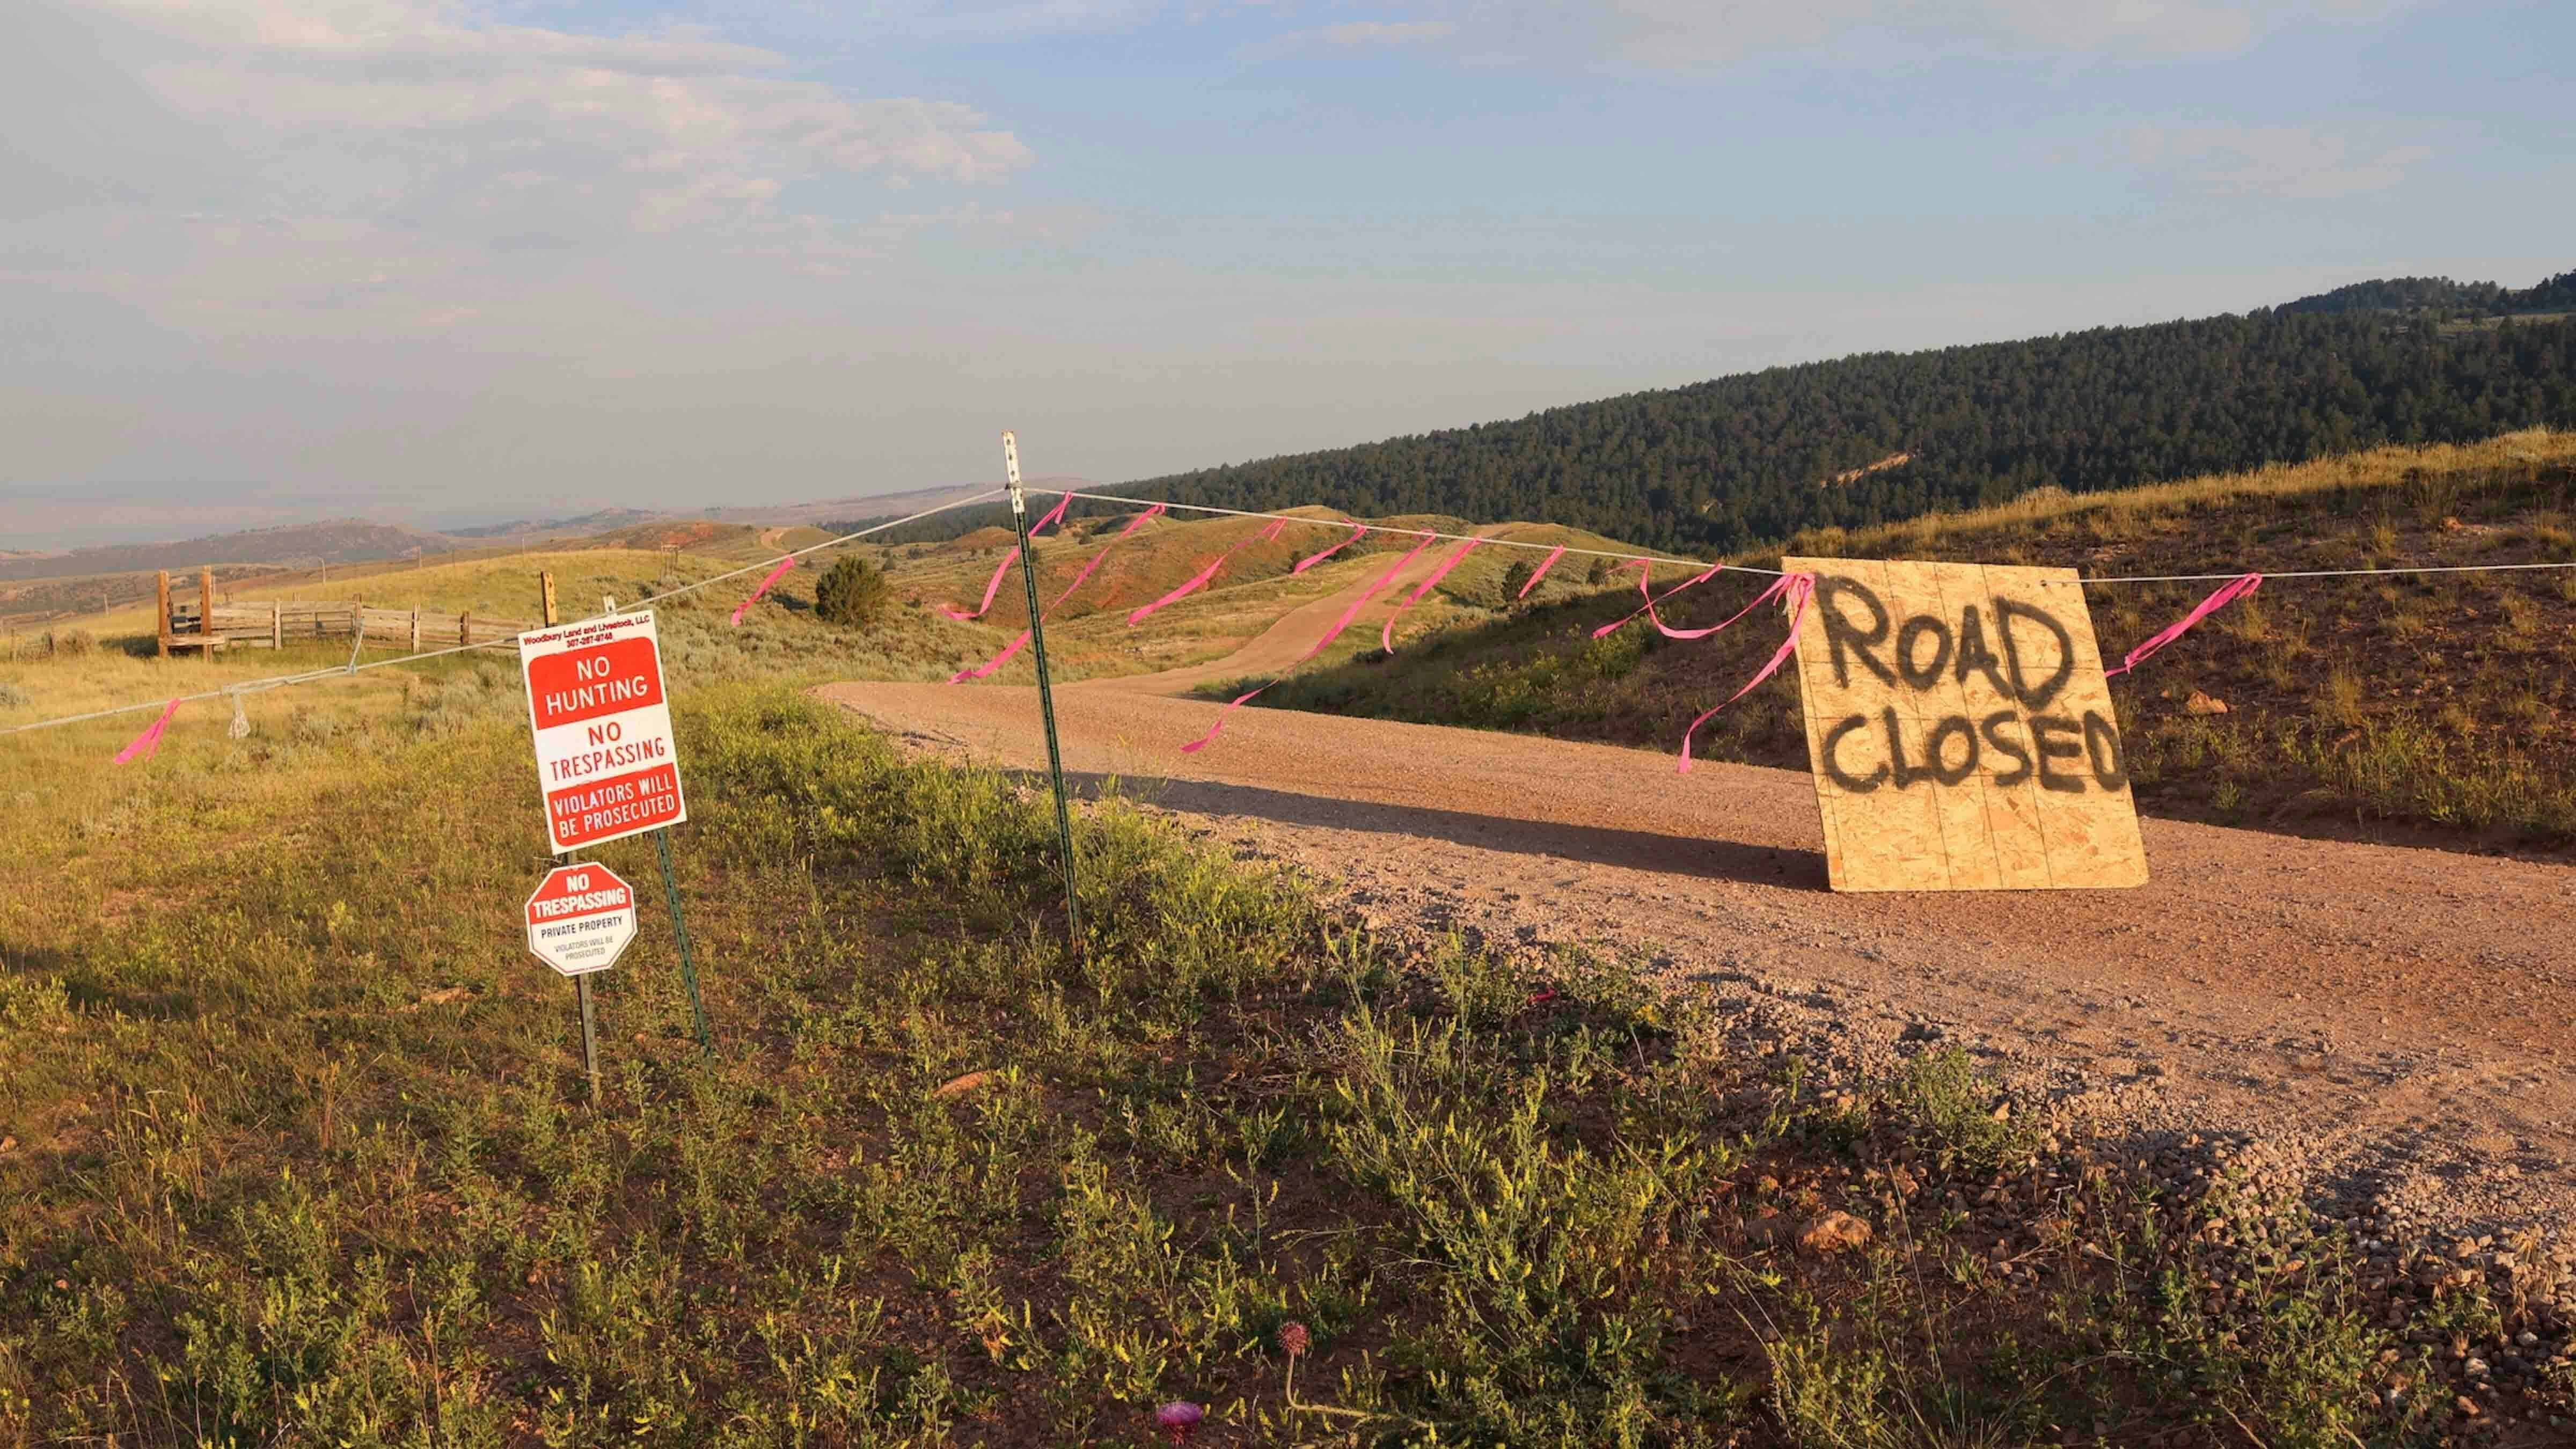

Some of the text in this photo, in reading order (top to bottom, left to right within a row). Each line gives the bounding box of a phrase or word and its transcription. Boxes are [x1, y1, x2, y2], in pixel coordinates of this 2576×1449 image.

[524, 615, 650, 646] Woodbury Land and Livestock, LLC
[1814, 570, 2075, 711] ROAD
[576, 656, 610, 682] NO
[545, 676, 648, 715] HUNTING
[588, 722, 621, 746] NO
[1821, 706, 2130, 793] CLOSED
[550, 737, 665, 781] TRESPASSING
[554, 773, 673, 816] VIOLATORS WILL
[559, 794, 675, 838] BE PROSECUTED
[566, 873, 590, 893] NO
[533, 888, 626, 919] TRESPASSING
[541, 916, 623, 939] PRIVATE PROPERTY
[554, 940, 589, 953] VIOLATORS
[589, 938, 604, 947] WILL
[565, 947, 605, 960] PROSECUTED
